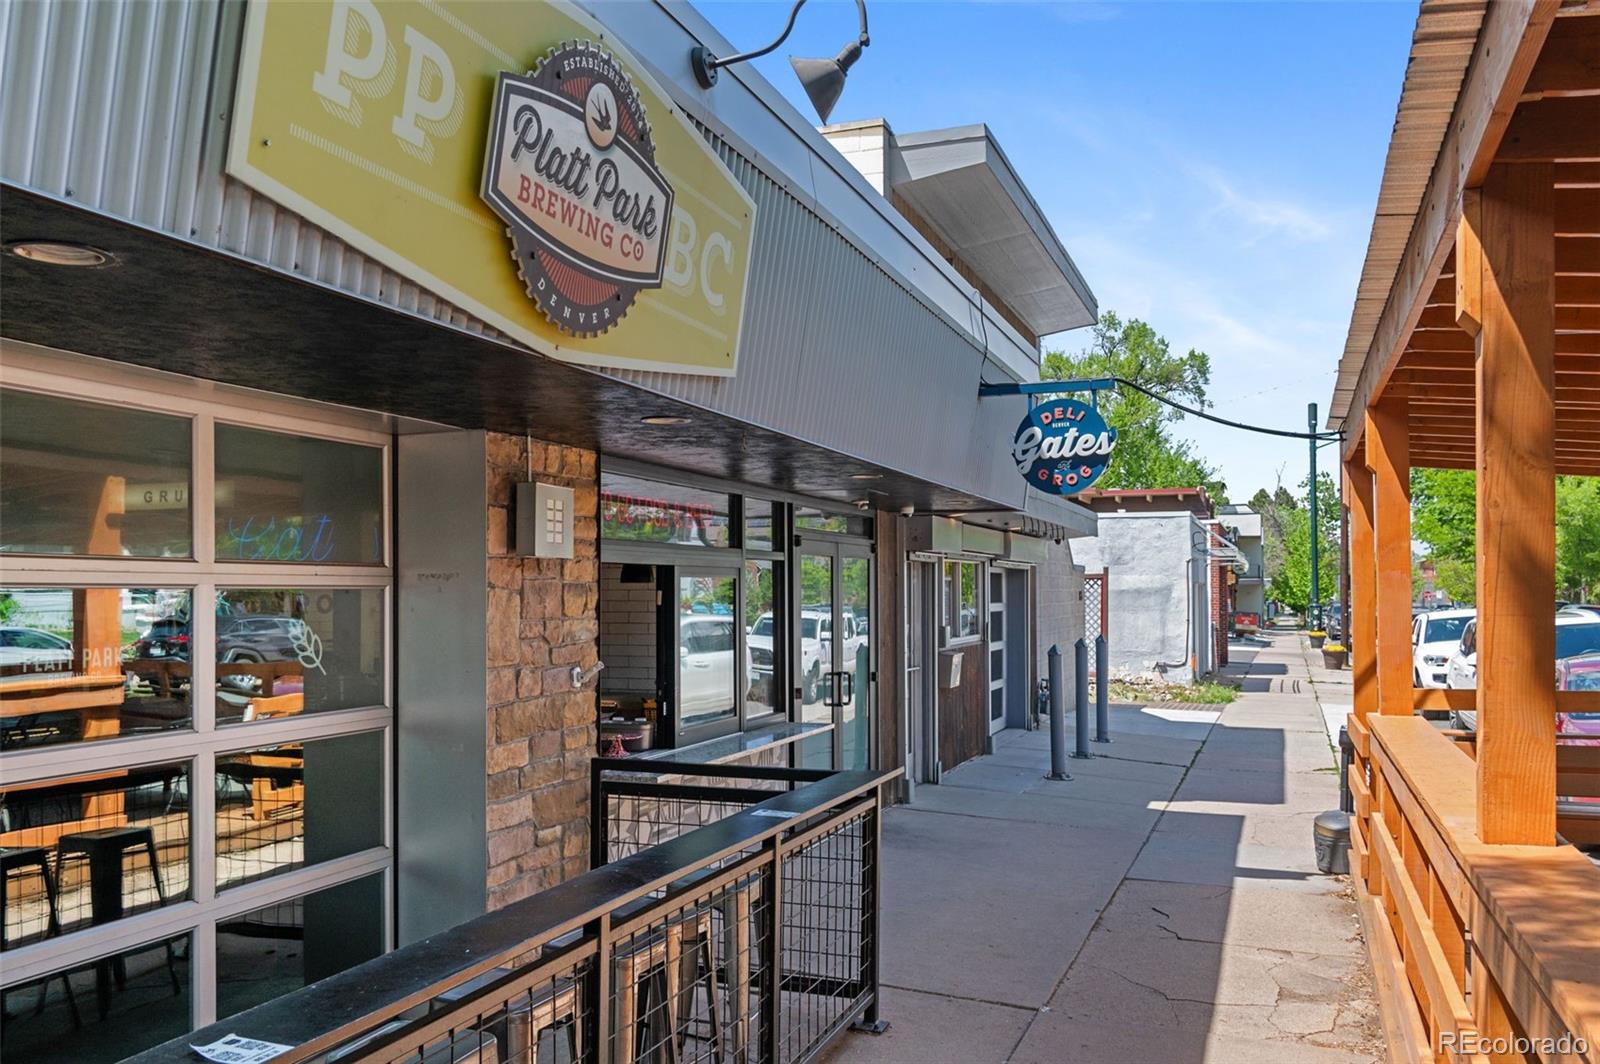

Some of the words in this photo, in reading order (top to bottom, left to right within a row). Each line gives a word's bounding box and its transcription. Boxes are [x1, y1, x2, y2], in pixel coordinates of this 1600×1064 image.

[312, 0, 458, 148] PP
[563, 56, 627, 92] ESTABLISHED
[511, 104, 592, 200] Platt
[593, 157, 658, 240] Park
[517, 173, 614, 250] BREWING
[619, 233, 646, 262] CO
[664, 204, 733, 307] BC
[537, 277, 610, 324] DENVER
[1040, 407, 1086, 425] DELI
[1012, 426, 1118, 475] Gates
[1038, 466, 1092, 486] GROG
